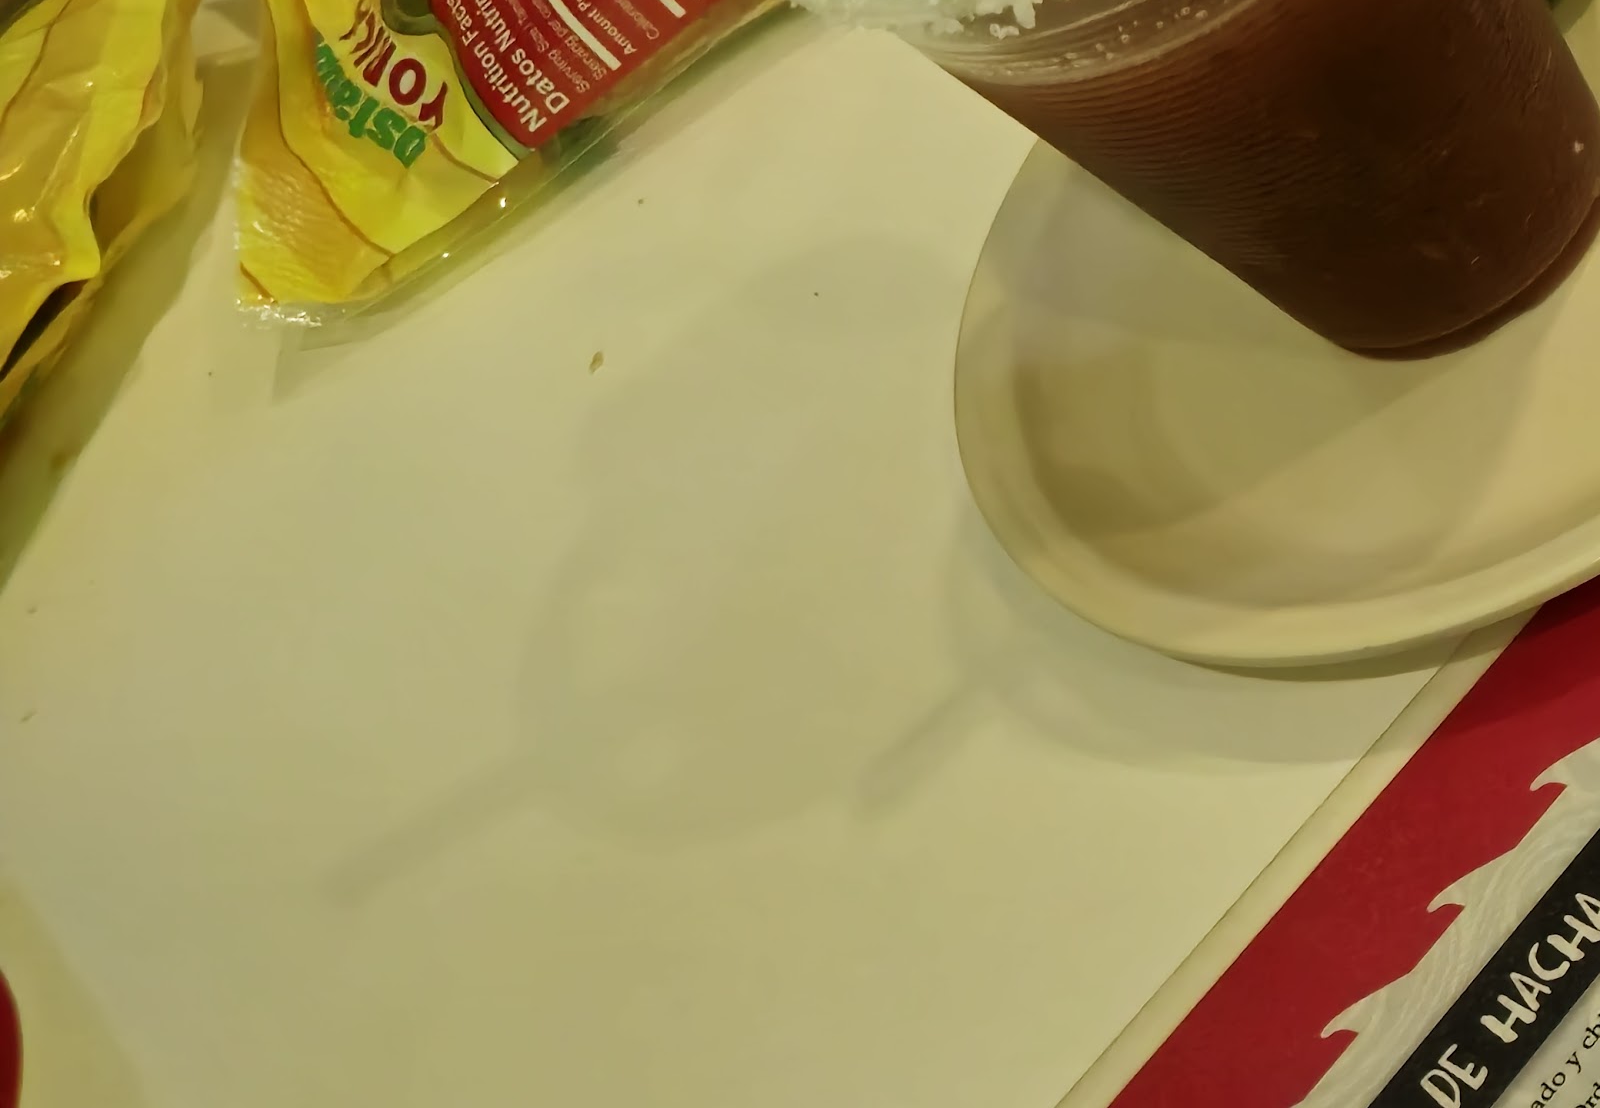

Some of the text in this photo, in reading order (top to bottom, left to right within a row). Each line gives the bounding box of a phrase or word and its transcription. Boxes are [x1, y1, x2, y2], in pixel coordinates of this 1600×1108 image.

[587, 8, 637, 55] Amount
[473, 40, 547, 132] Nutrition
[511, 48, 570, 114] Datos
[1420, 1043, 1489, 1108] DE
[1565, 1051, 1583, 1074] y
